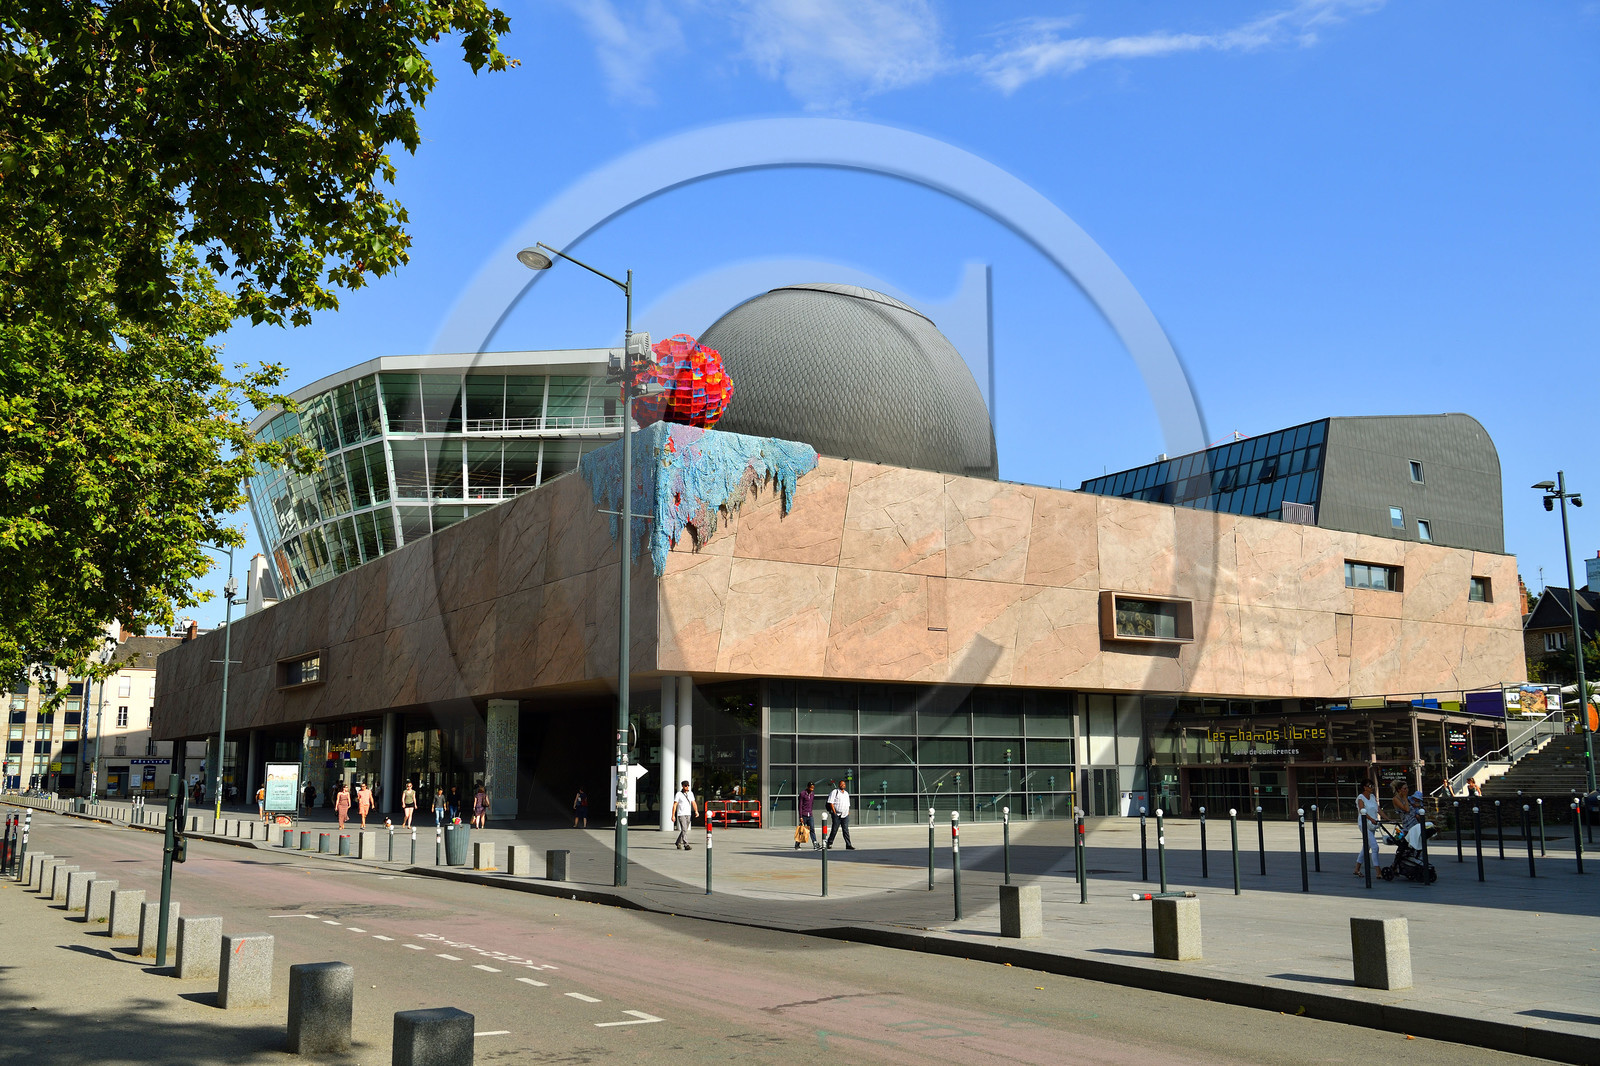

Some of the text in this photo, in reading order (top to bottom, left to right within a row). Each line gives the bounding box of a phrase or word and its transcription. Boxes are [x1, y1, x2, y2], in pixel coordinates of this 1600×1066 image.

[1207, 725, 1327, 743] les champs libres
